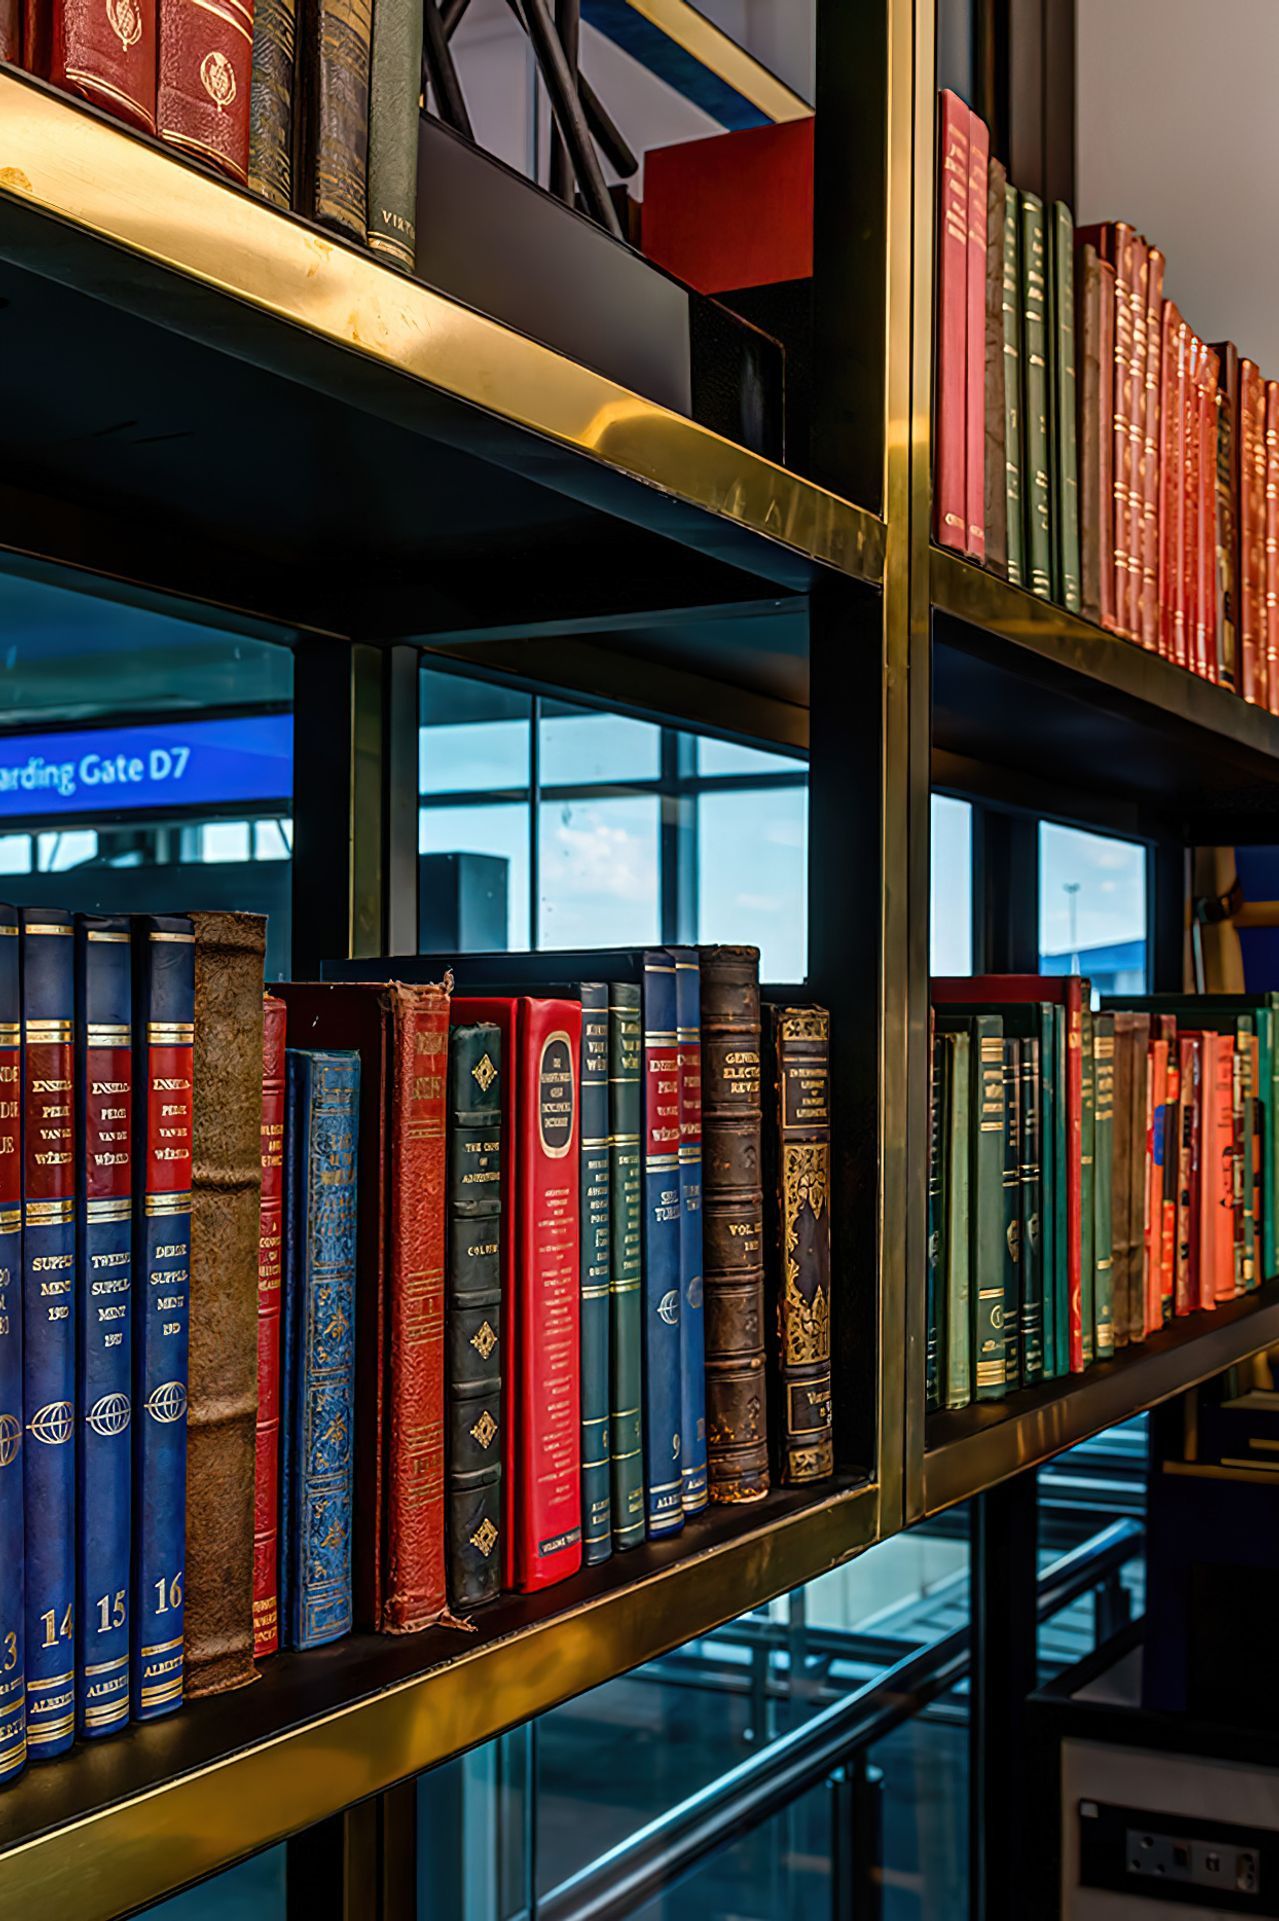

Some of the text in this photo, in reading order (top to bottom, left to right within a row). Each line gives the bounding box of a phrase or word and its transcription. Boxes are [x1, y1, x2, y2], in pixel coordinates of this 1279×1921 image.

[79, 754, 144, 785] Gate
[149, 747, 190, 780] D7
[97, 1589, 126, 1633] 15
[154, 1570, 183, 1615] 16
[40, 1602, 73, 1648] 14
[0, 1631, 17, 1675] 3
